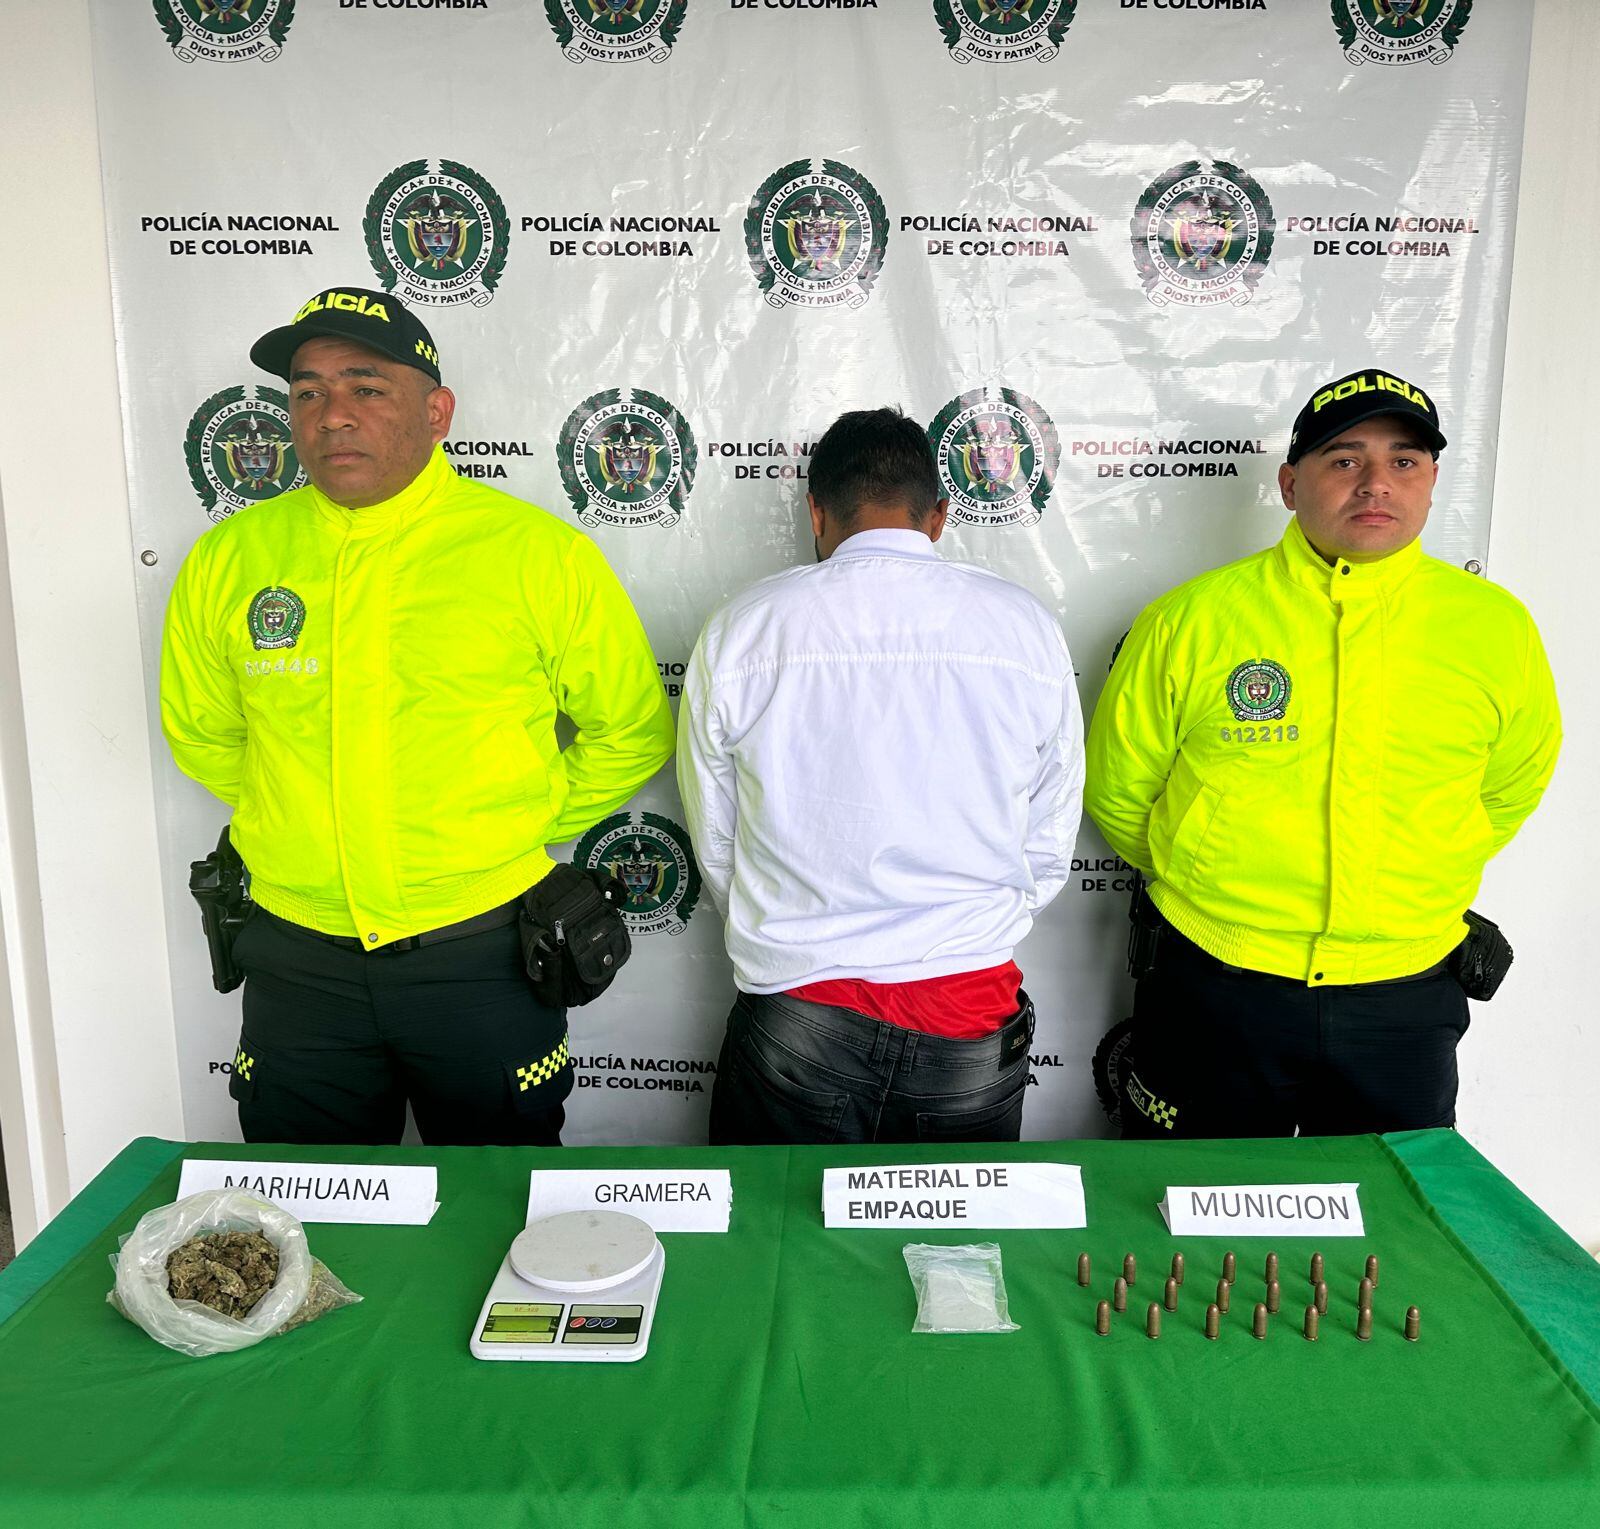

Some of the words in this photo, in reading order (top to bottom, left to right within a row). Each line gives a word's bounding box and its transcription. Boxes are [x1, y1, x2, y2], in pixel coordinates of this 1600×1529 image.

[227, 7, 276, 44] NACIONAL
[617, 8, 667, 44] NACIONAL
[1005, 7, 1057, 44] NACIONAL
[1398, 10, 1451, 47] NACIONAL
[228, 41, 265, 59] PATRIA
[617, 41, 656, 59] PATRIA
[1004, 41, 1043, 59] PATRIA
[1397, 45, 1437, 62] PATRIA
[428, 176, 445, 185] DE
[456, 184, 491, 242] COLOMBIA
[811, 176, 827, 185] DE
[838, 184, 871, 243] COLOMBIA
[1200, 176, 1216, 185] DE
[1226, 184, 1257, 243] COLOMBIA
[141, 212, 223, 231] POLICÍA
[227, 216, 339, 231] NACIONAL
[521, 212, 604, 232] POLICÍA
[610, 216, 721, 232] NACIONAL
[900, 213, 982, 233] POLICÍA
[987, 216, 1099, 232] NACIONAL
[1287, 213, 1370, 232] POLICÍA
[1374, 216, 1479, 234] NACIONAL
[169, 240, 197, 255] DE
[201, 239, 314, 255] COLOMBIA
[550, 240, 577, 256] DE
[582, 240, 694, 257] COLOMBIA
[927, 240, 954, 255] DE
[959, 240, 1070, 256] COLOMBIA
[1313, 240, 1340, 255] DE
[1345, 240, 1451, 257] COLOMBIA
[440, 255, 488, 290] NACIONAL
[817, 256, 866, 290] NACIONAL
[1201, 254, 1252, 289] NACIONAL
[440, 287, 478, 304] PATRIA
[817, 288, 854, 305] PATRIA
[1200, 286, 1238, 304] PATRIA
[246, 401, 261, 410] DE
[621, 405, 636, 413] DE
[647, 411, 680, 467] COLOMBIA
[987, 404, 1003, 412] DE
[1013, 410, 1043, 467] COLOMBIA
[442, 441, 534, 456] ACIONAL
[708, 438, 788, 457] POLICÍA
[1072, 437, 1153, 455] POLICÍA
[1159, 440, 1267, 455] NACIONAL
[735, 465, 760, 479] DE
[1097, 463, 1124, 478] DE
[1129, 462, 1239, 478] COLOMBIA
[629, 478, 676, 512] NACIONAL
[991, 478, 1040, 511] NACIONAL
[629, 509, 665, 525] PATRIA
[990, 508, 1027, 524] PATRIA
[1220, 725, 1299, 742] 612218
[631, 826, 646, 834] DE
[656, 832, 687, 882] COLOMBIA
[1070, 856, 1133, 872] OLICÍA
[1082, 879, 1106, 892] DE
[639, 891, 682, 921] NACIONAL
[638, 918, 673, 933] PATRIA
[569, 1054, 626, 1070] OLICÍA
[630, 1058, 717, 1074] NACIONA
[578, 1076, 602, 1088] DE
[606, 1077, 705, 1093] COLOMBIA
[848, 1169, 969, 1190] MATERIAL
[976, 1168, 1009, 1188] DE
[595, 1182, 712, 1203] GRAMERA
[848, 1200, 967, 1220] EMPAQUE
[1191, 1191, 1350, 1220] MUNICION
